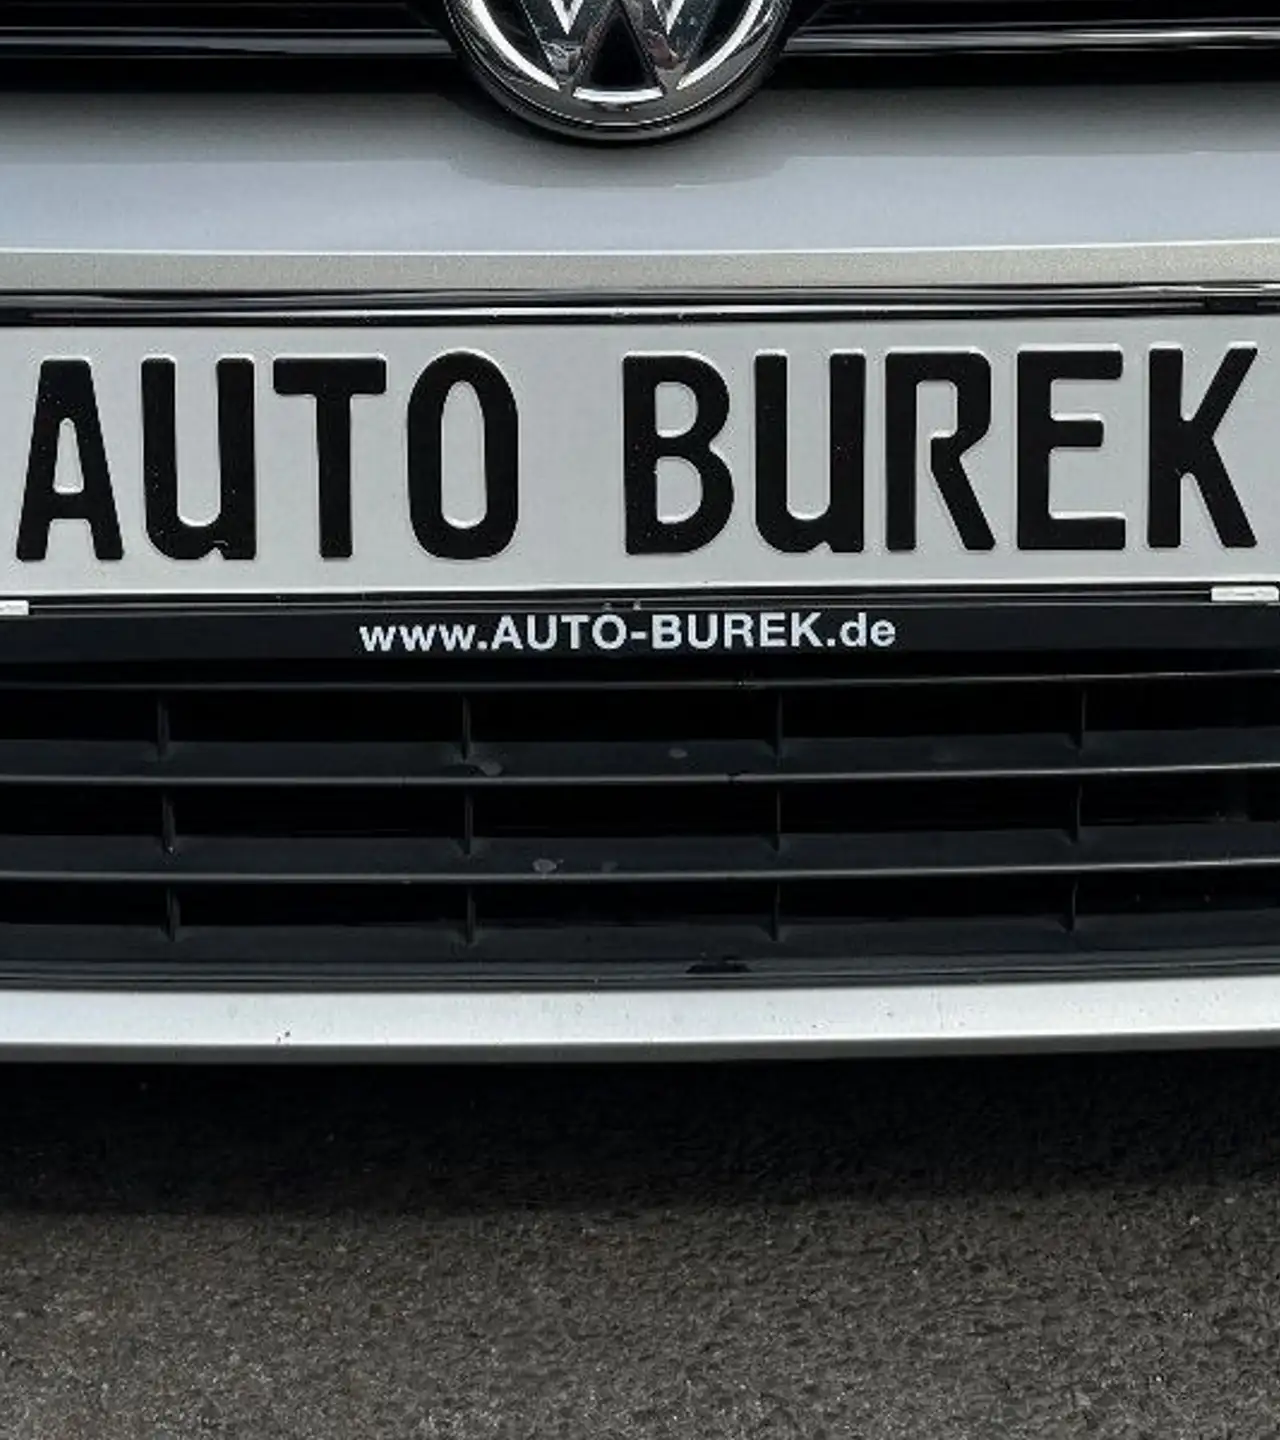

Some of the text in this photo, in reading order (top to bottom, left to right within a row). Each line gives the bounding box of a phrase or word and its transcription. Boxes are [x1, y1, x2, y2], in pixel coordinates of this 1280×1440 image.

[15, 347, 1259, 563] AUTO BUREK
[359, 611, 897, 652] www.AUTO-BUREK.de
